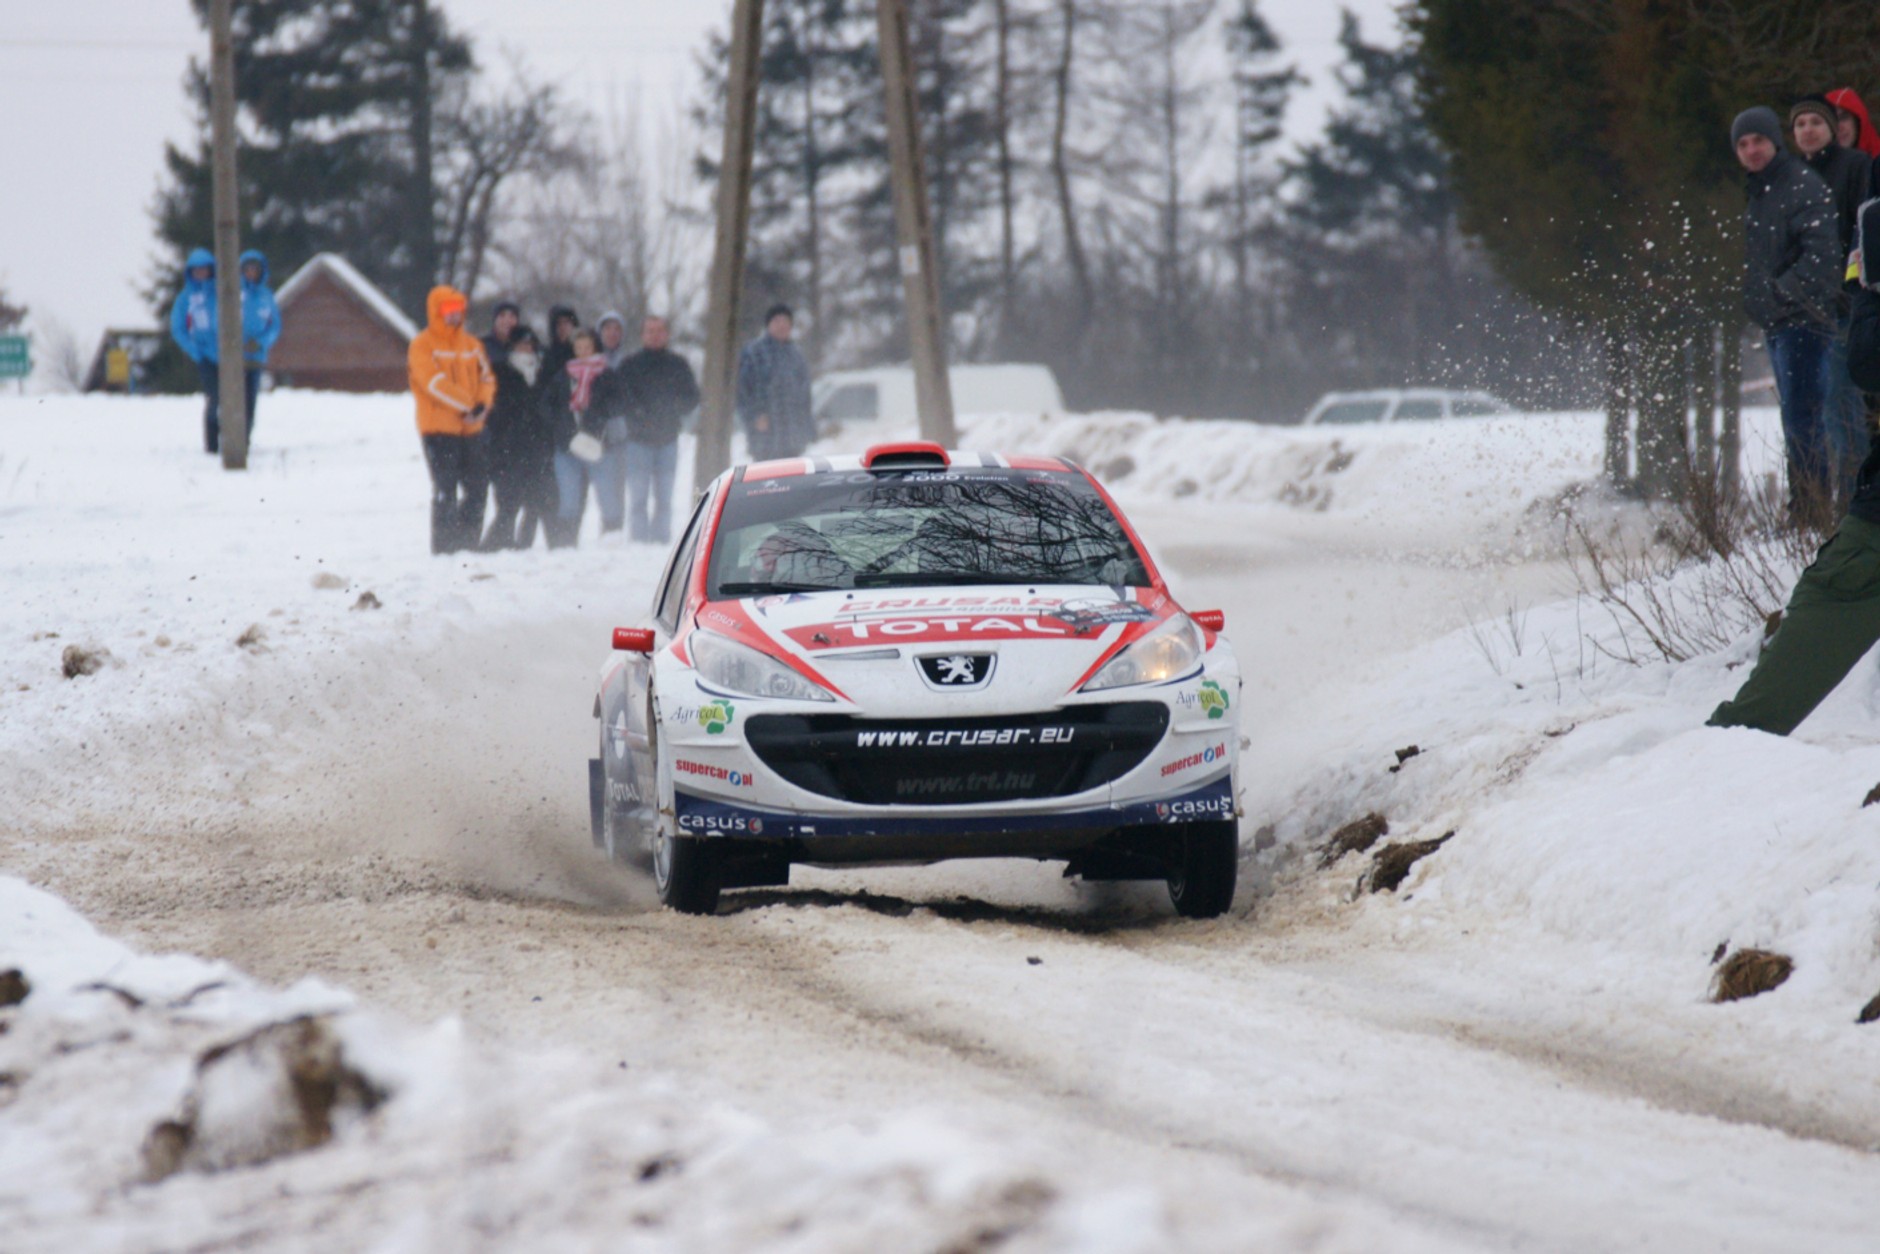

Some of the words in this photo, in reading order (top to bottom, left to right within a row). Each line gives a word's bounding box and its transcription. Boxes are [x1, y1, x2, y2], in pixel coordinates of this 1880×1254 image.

[707, 610, 736, 627] casus
[833, 618, 1066, 639] TOTAL
[617, 630, 647, 639] TOTAL
[857, 727, 1075, 747] www.crusar.eu
[675, 759, 729, 780] supercar
[1160, 751, 1204, 777] supercar
[896, 772, 1036, 794] www.trt.hu
[1171, 798, 1230, 815] casus
[678, 814, 747, 830] casus
